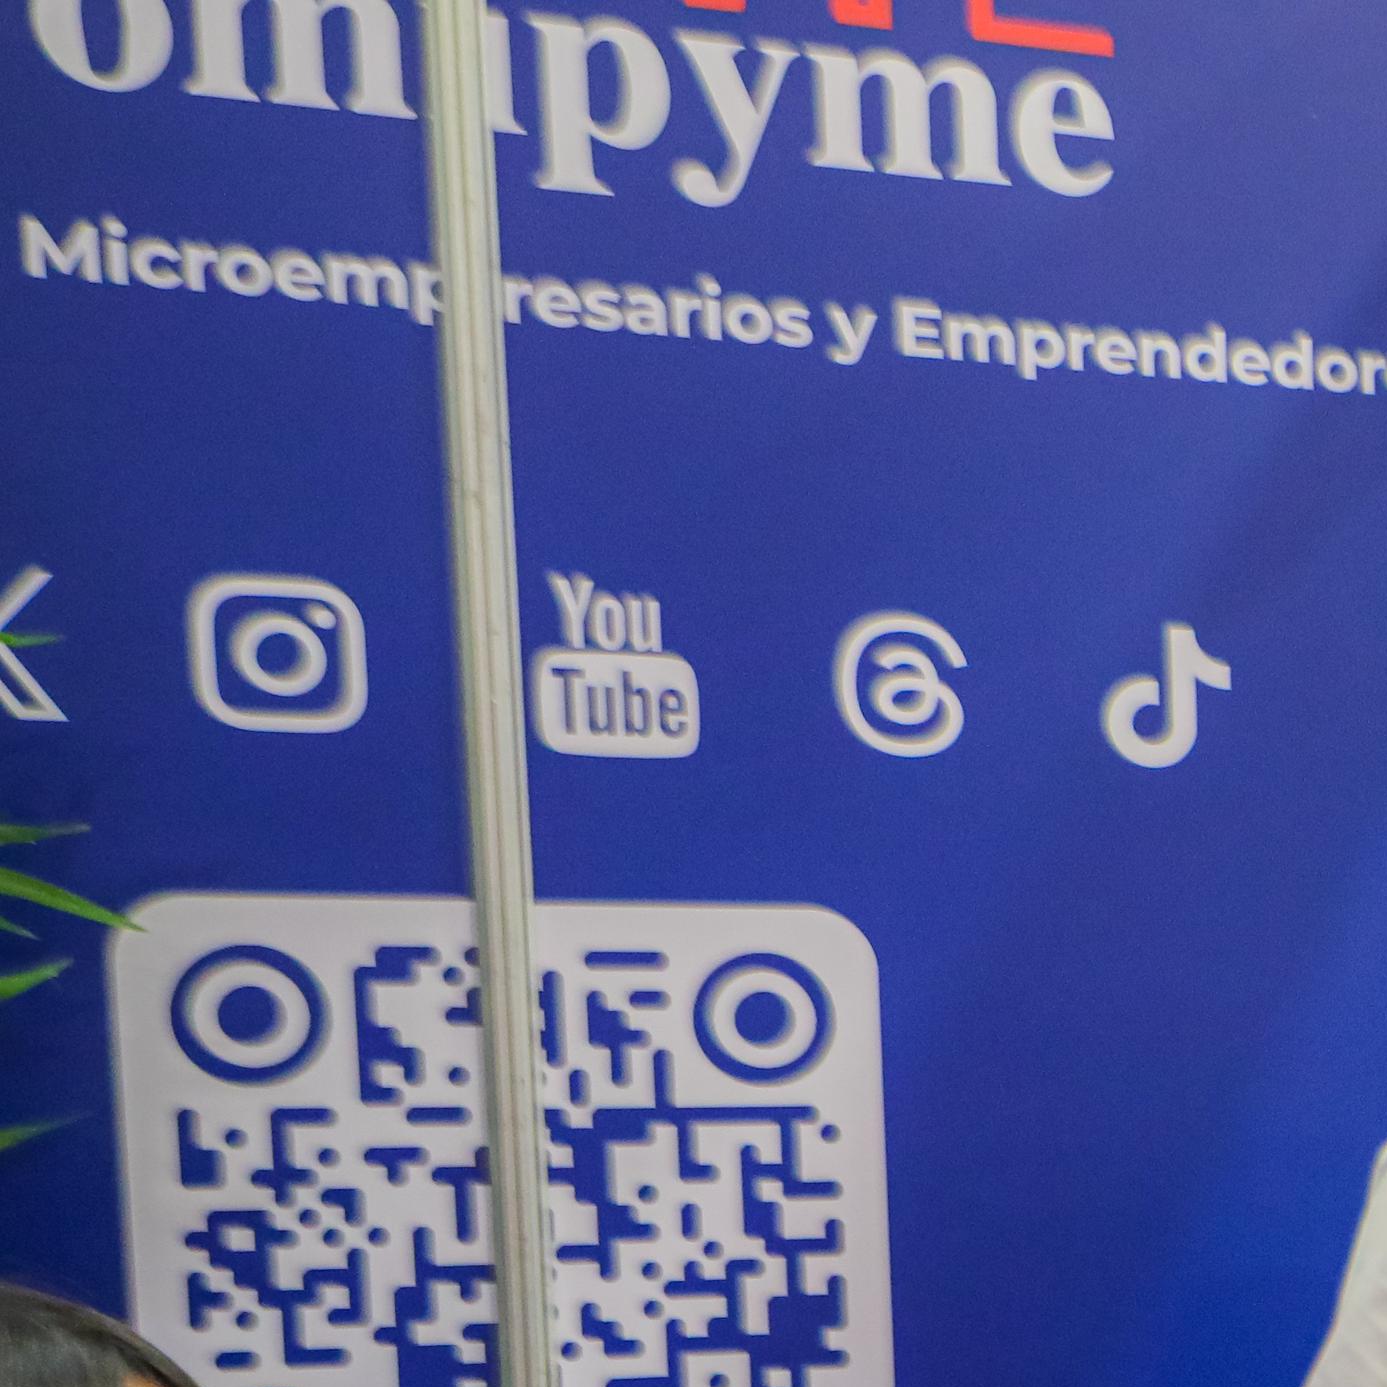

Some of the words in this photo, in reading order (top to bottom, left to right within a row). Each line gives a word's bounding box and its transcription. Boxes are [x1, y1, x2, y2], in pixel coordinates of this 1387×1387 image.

[19, 212, 815, 350] Microempresarios
[825, 304, 878, 366] y
[548, 572, 664, 653] You
[551, 668, 689, 739] Tube
